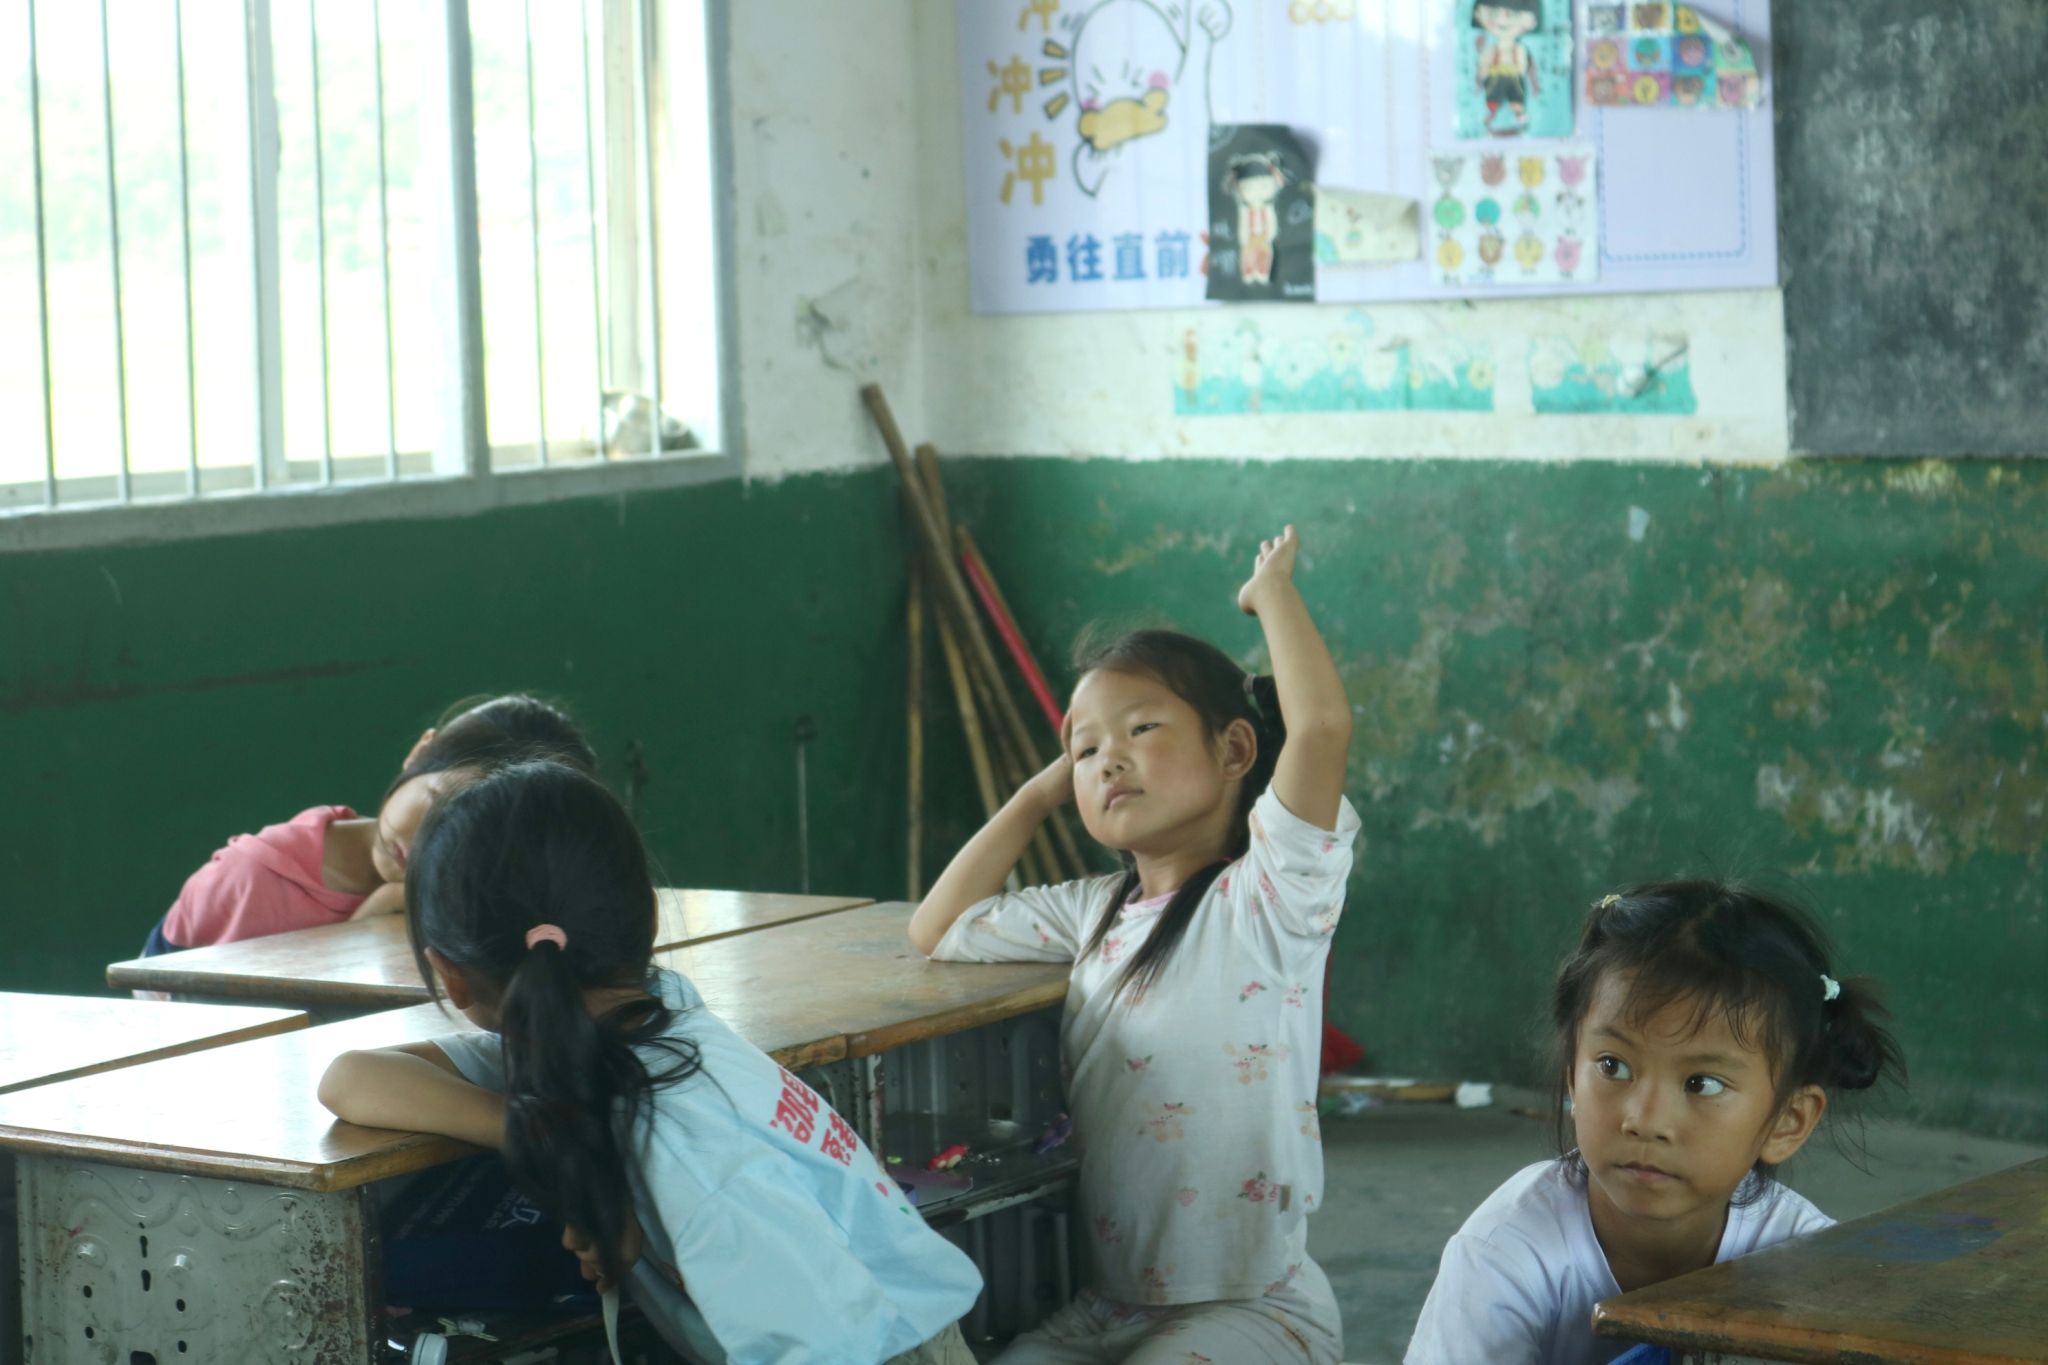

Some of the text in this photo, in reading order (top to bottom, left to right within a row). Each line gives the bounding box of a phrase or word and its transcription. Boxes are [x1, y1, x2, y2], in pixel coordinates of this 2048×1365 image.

[986, 54, 1033, 114] 冲
[998, 130, 1057, 207] 冲
[1026, 231, 1208, 284] 勇往直前
